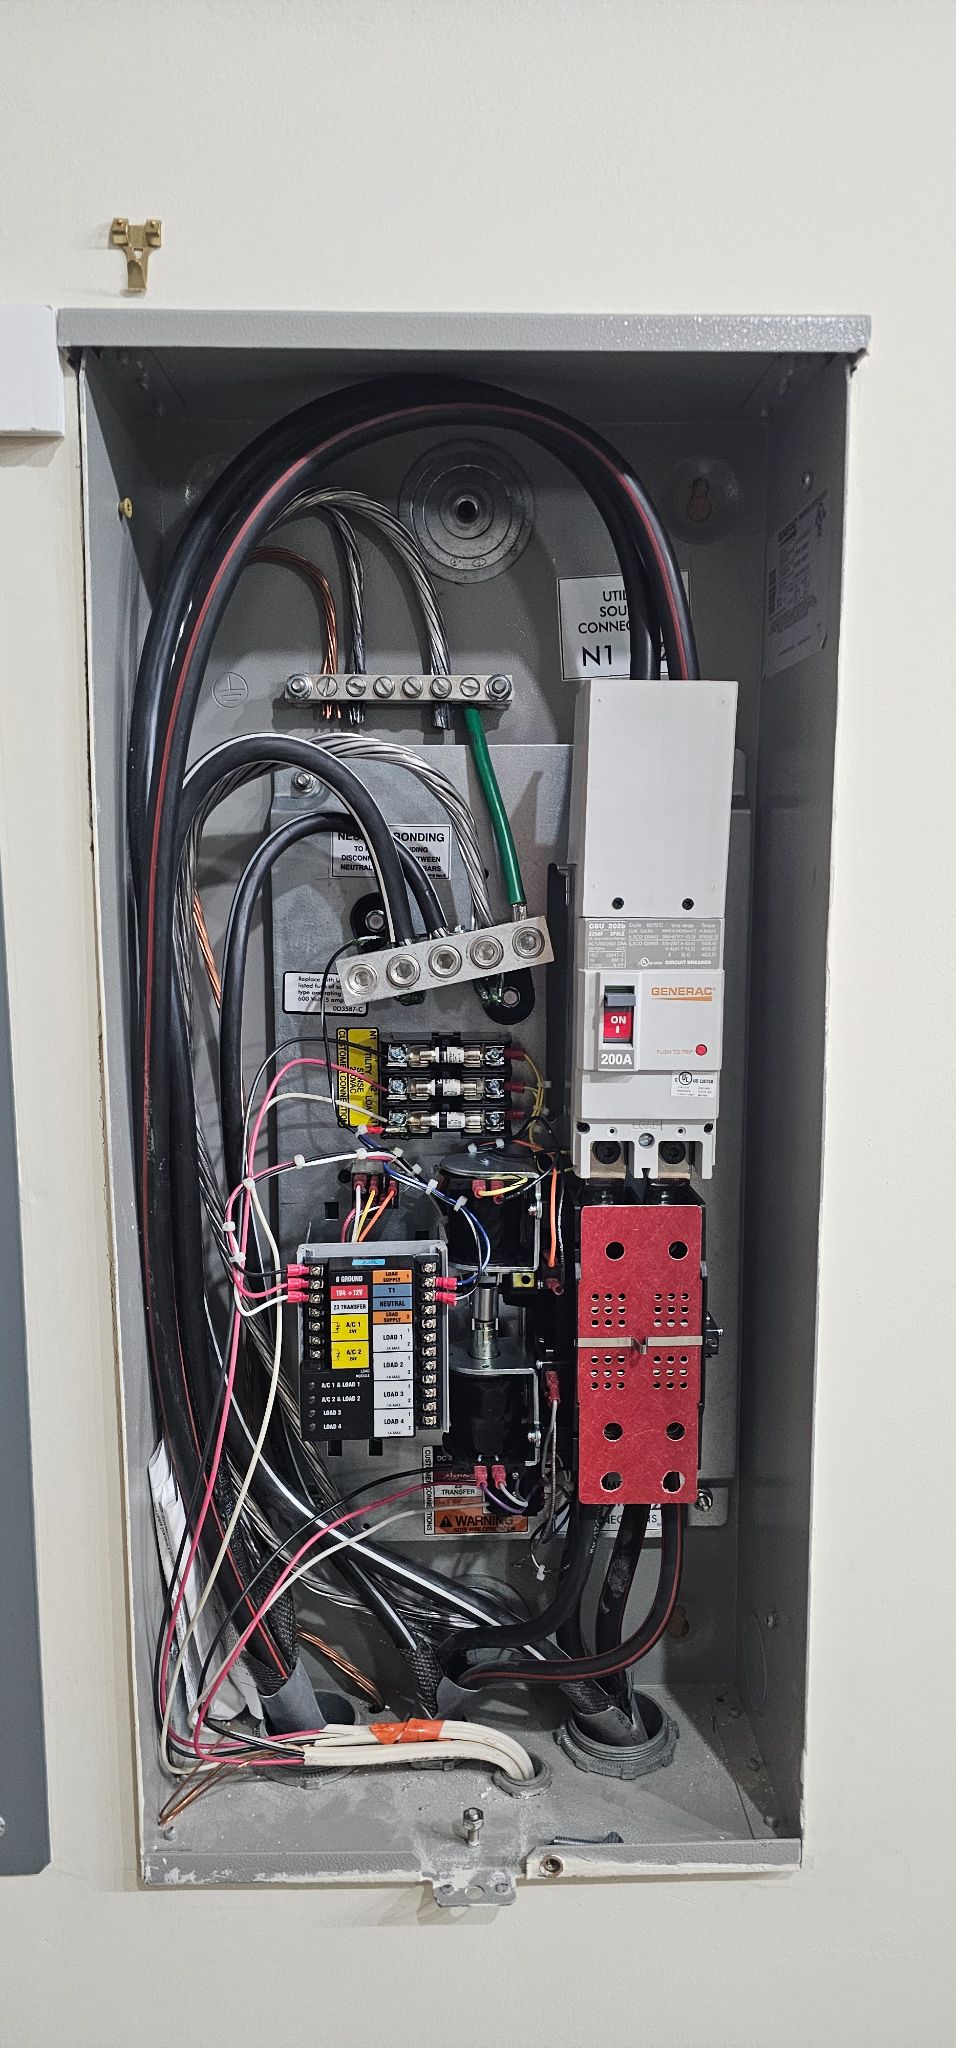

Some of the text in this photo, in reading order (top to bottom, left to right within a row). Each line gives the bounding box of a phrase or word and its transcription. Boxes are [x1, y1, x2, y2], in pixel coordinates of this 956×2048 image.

[603, 590, 628, 602] UTIL
[600, 606, 628, 617] SOU
[582, 645, 613, 666] N1
[393, 833, 445, 842] BONDING
[651, 987, 712, 996] GENERAC
[610, 1016, 626, 1024] ON
[370, 1030, 377, 1040] N1
[600, 1054, 632, 1064] 200A
[455, 1515, 514, 1526] WARNING
